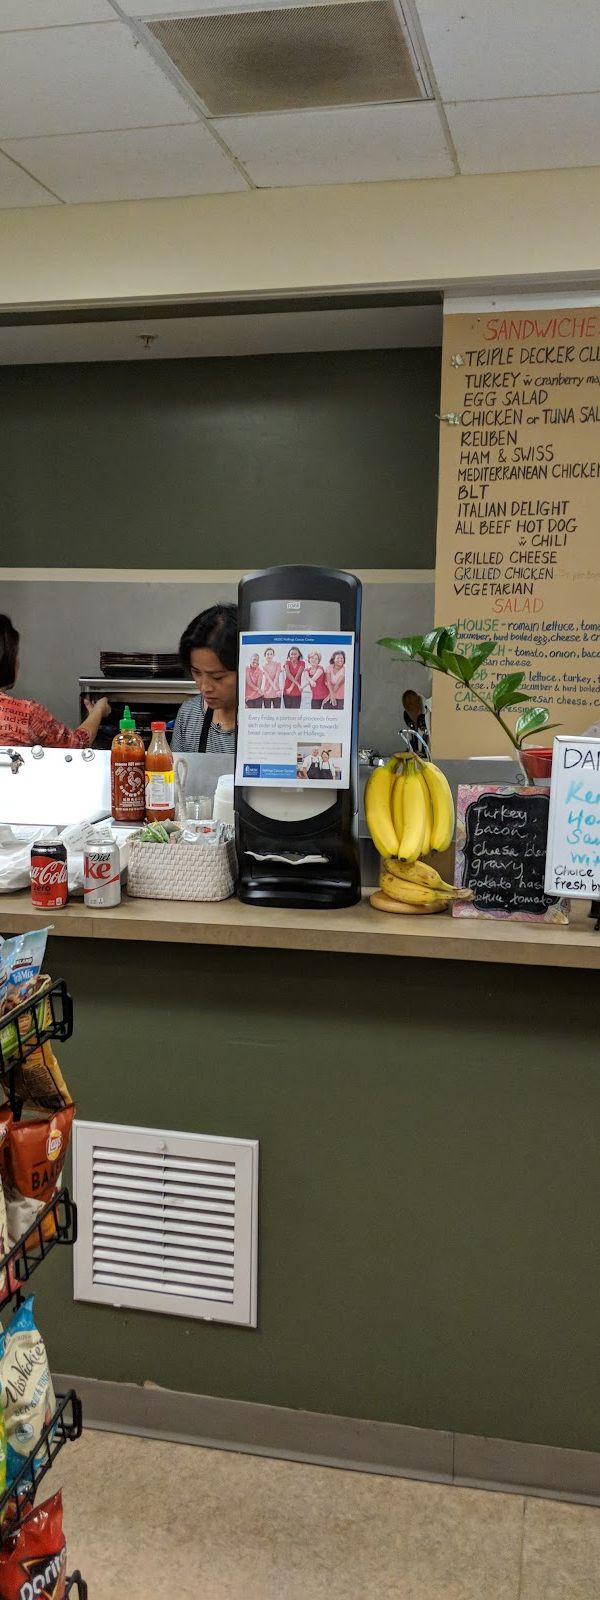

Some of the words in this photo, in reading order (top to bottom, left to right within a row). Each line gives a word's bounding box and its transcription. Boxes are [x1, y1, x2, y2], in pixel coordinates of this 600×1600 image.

[484, 317, 600, 341] SANDWICHE
[465, 347, 514, 367] TRIPLE
[520, 345, 575, 364] DECKER
[465, 372, 521, 389] TURKEY
[534, 373, 584, 387] cranberry
[463, 392, 497, 407] EGG
[502, 390, 549, 406] SALAD
[460, 409, 523, 427] CHICKEN
[527, 416, 540, 424] or
[542, 407, 575, 424] TUNA
[579, 406, 600, 423] SAL
[460, 430, 518, 447] REUBEN
[460, 450, 490, 465] HAM
[498, 449, 506, 463] &
[511, 444, 554, 463] SWISS
[457, 465, 548, 482] MEDITERRANEAN
[457, 484, 489, 500] BLT
[458, 502, 507, 518] ITALIAN
[511, 500, 570, 517] DELIGHT
[455, 521, 475, 535] ALL
[479, 519, 512, 535] BEEF
[516, 519, 544, 533] HOT
[548, 518, 578, 533] DOG
[531, 533, 567, 547] CHILI
[454, 551, 504, 565] GRILLED
[509, 550, 558, 565] CHEESE
[454, 566, 501, 581] GRILLED
[504, 567, 554, 581] CHICKEN
[453, 583, 534, 596] VEGETARIAN
[492, 597, 544, 614] SALAD
[457, 618, 500, 632] HOUSE
[511, 633, 532, 641] boiled
[550, 632, 581, 642] cheese
[583, 633, 589, 641] &
[499, 657, 532, 667] cheese
[89, 853, 111, 861] Diet
[84, 855, 112, 880] ke
[554, 876, 587, 890] fresh
